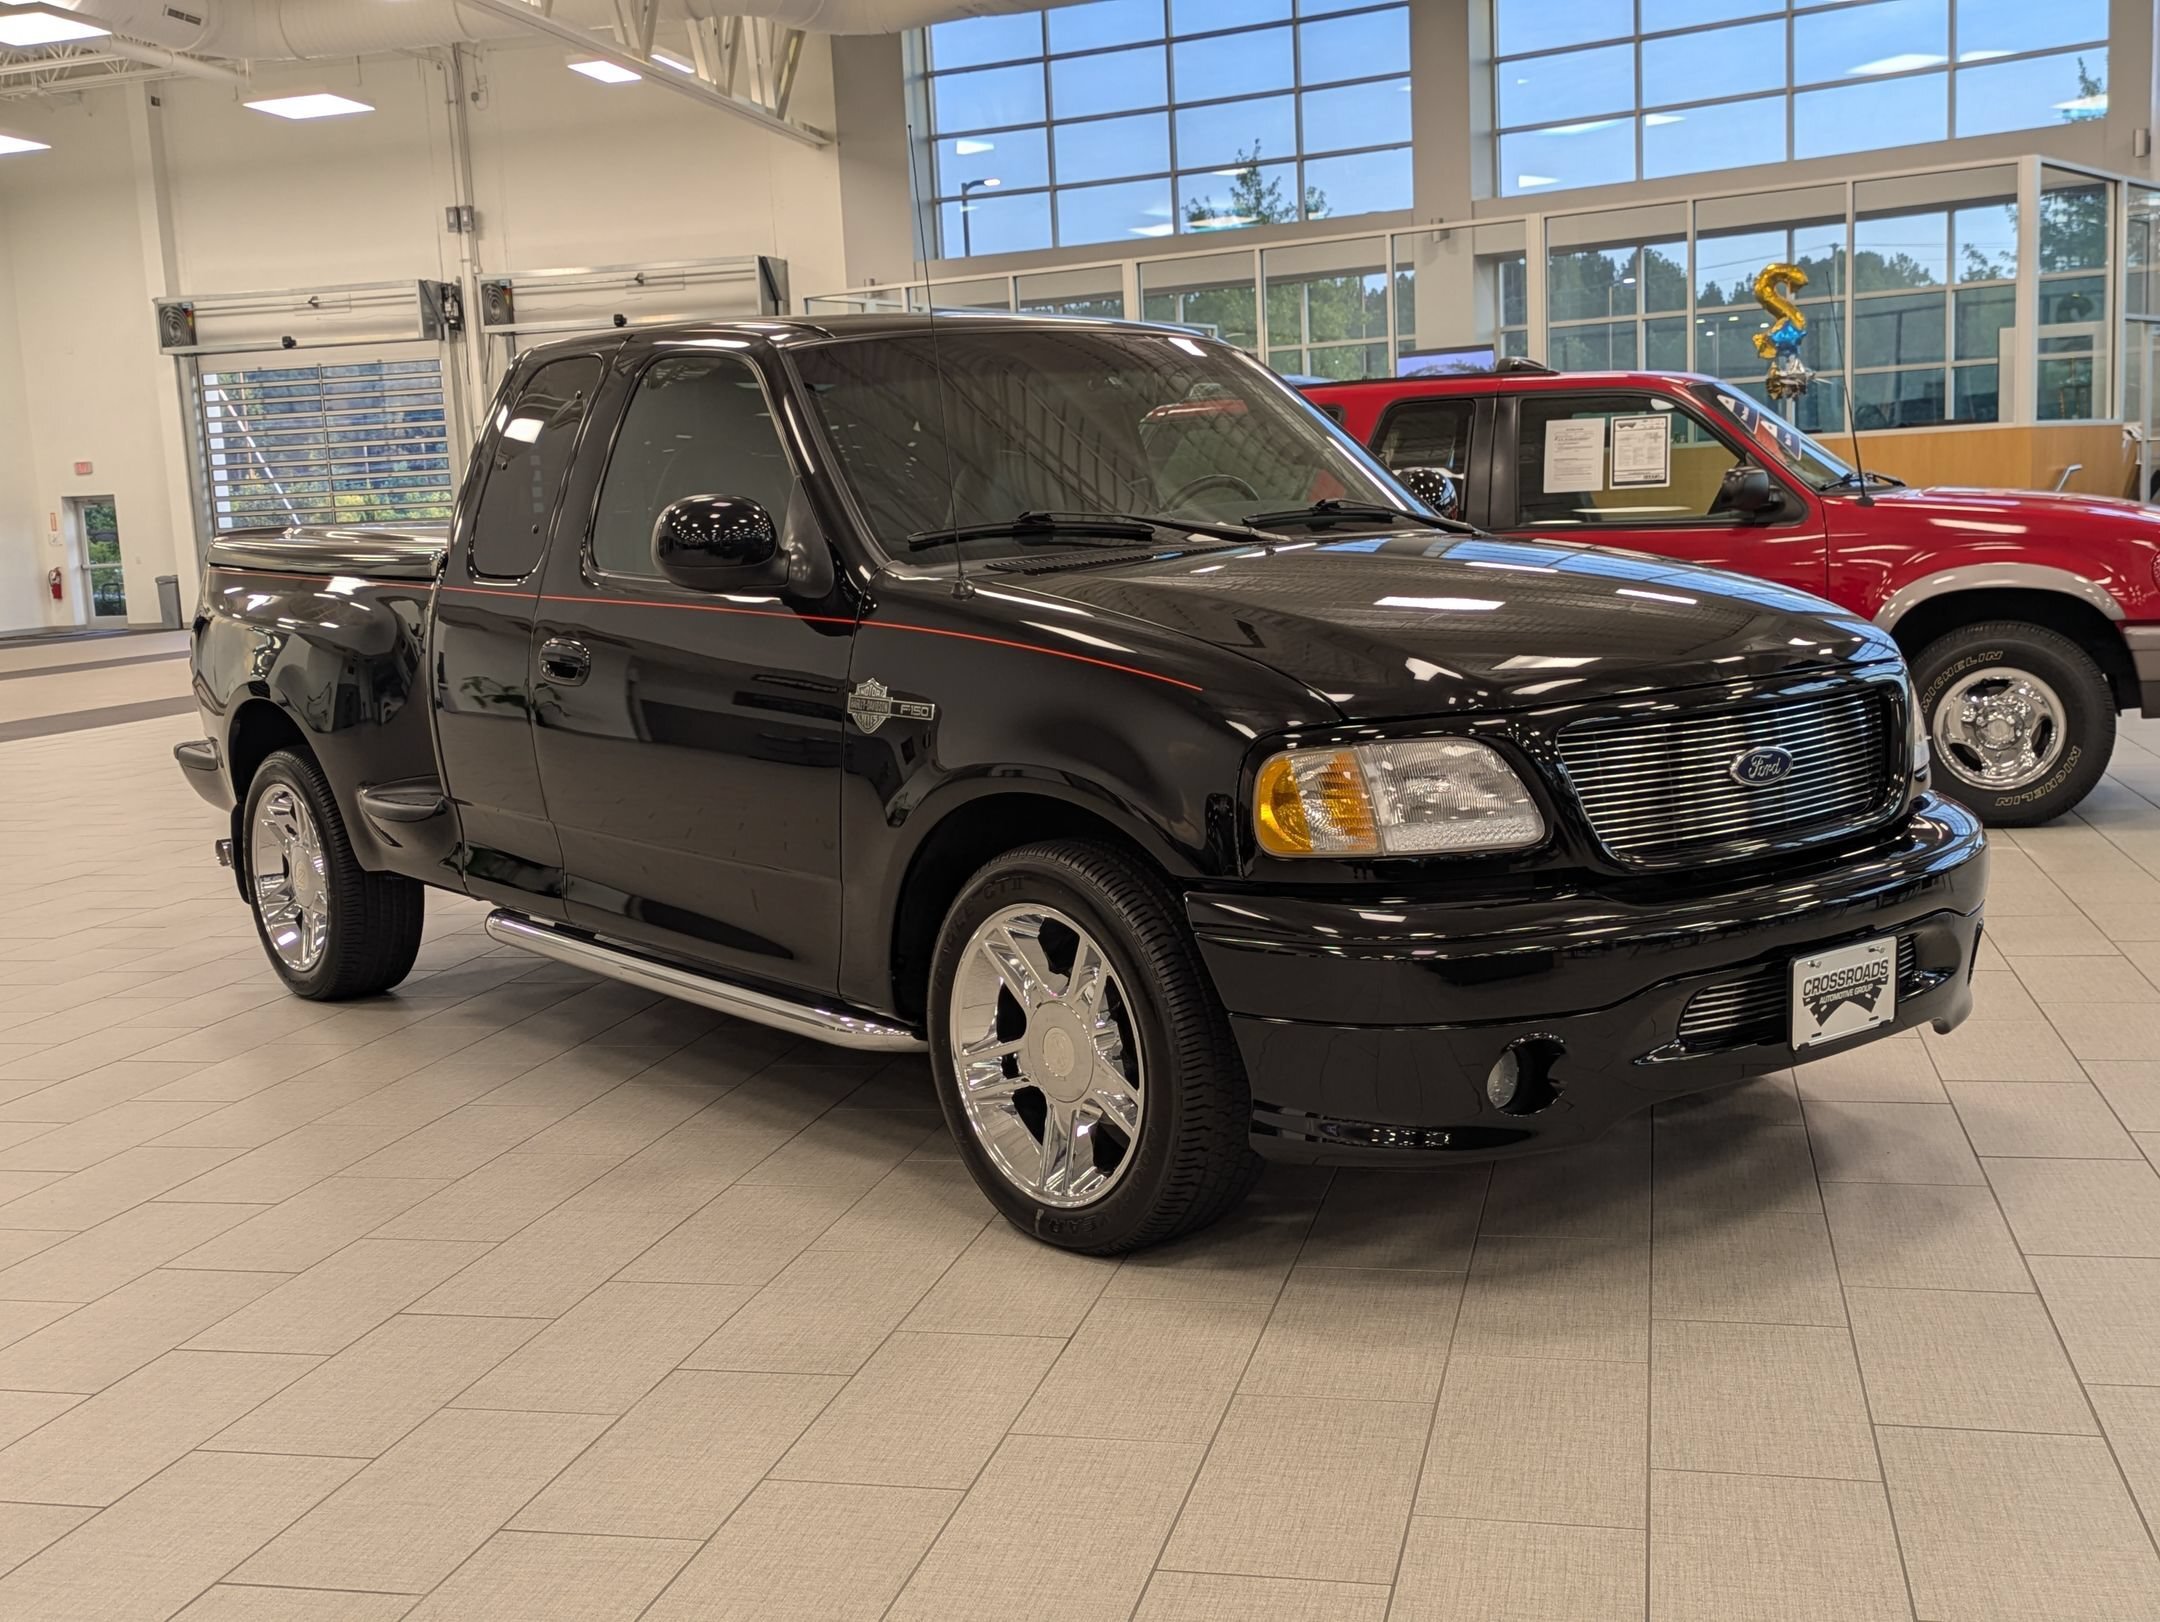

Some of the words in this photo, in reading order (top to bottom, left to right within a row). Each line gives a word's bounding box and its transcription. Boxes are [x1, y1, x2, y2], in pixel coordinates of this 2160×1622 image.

[1921, 650, 2004, 714] MICHELIN
[1748, 753, 1782, 779] Ford
[1994, 745, 2082, 807] MICHELIN
[1803, 959, 1889, 996] CROSSROADS
[1819, 988, 1854, 1004] AUTOMOTIVE
[1854, 984, 1874, 996] GROUP
